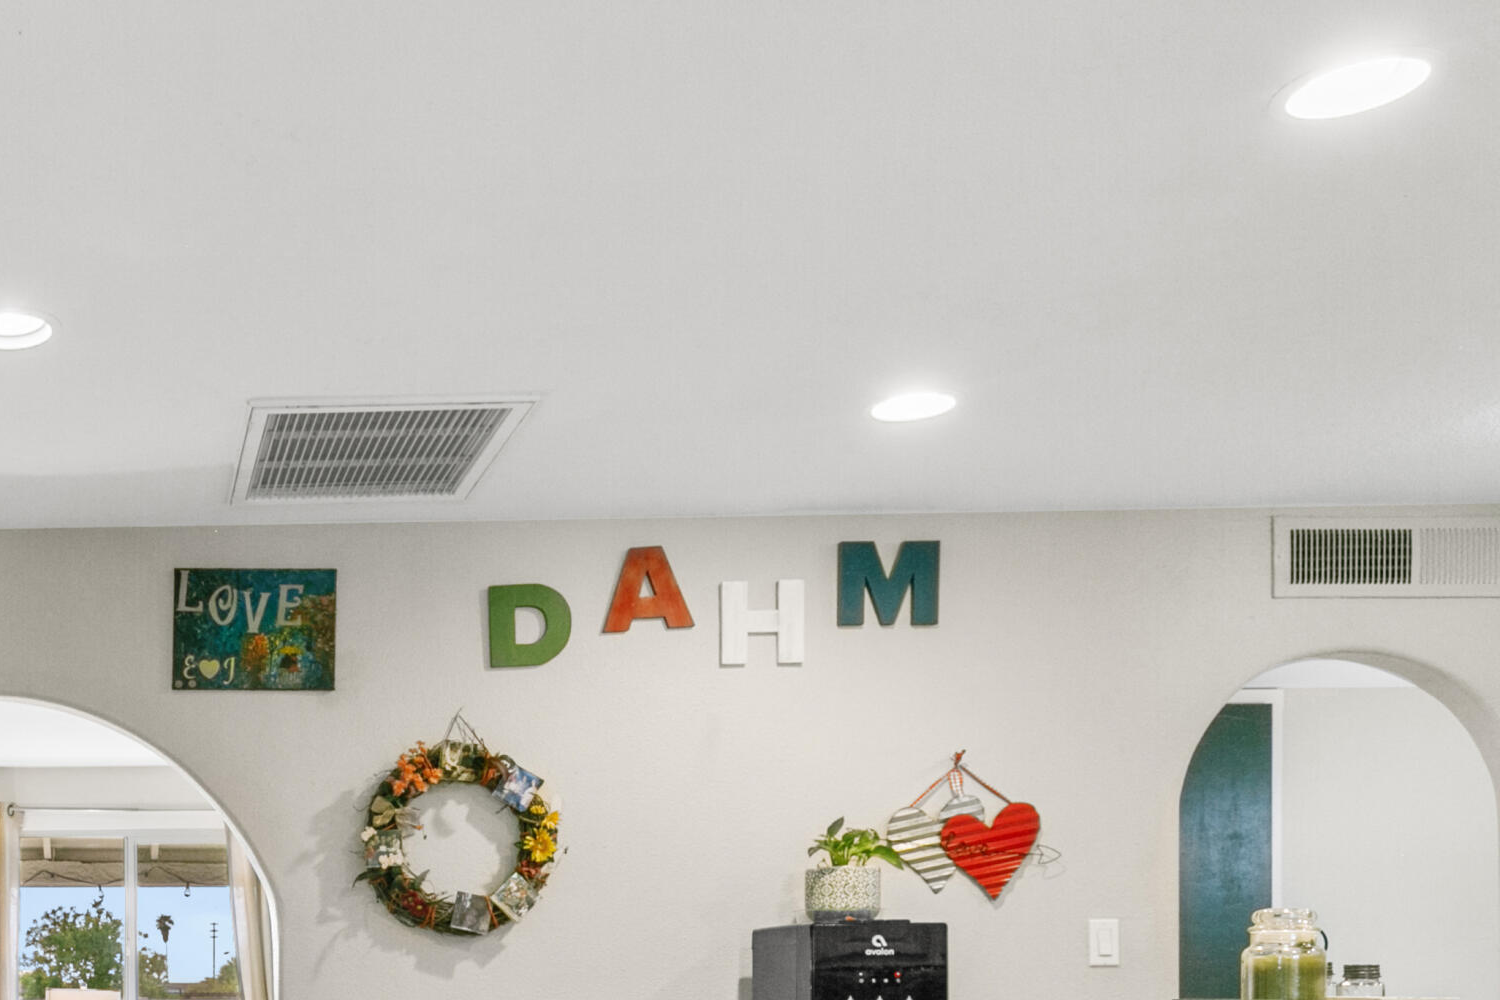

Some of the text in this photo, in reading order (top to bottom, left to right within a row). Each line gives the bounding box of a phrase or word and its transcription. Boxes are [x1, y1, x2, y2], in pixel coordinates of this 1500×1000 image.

[176, 570, 305, 634] LOVE
[488, 541, 941, 668] DAHM
[864, 947, 895, 956] avalon
